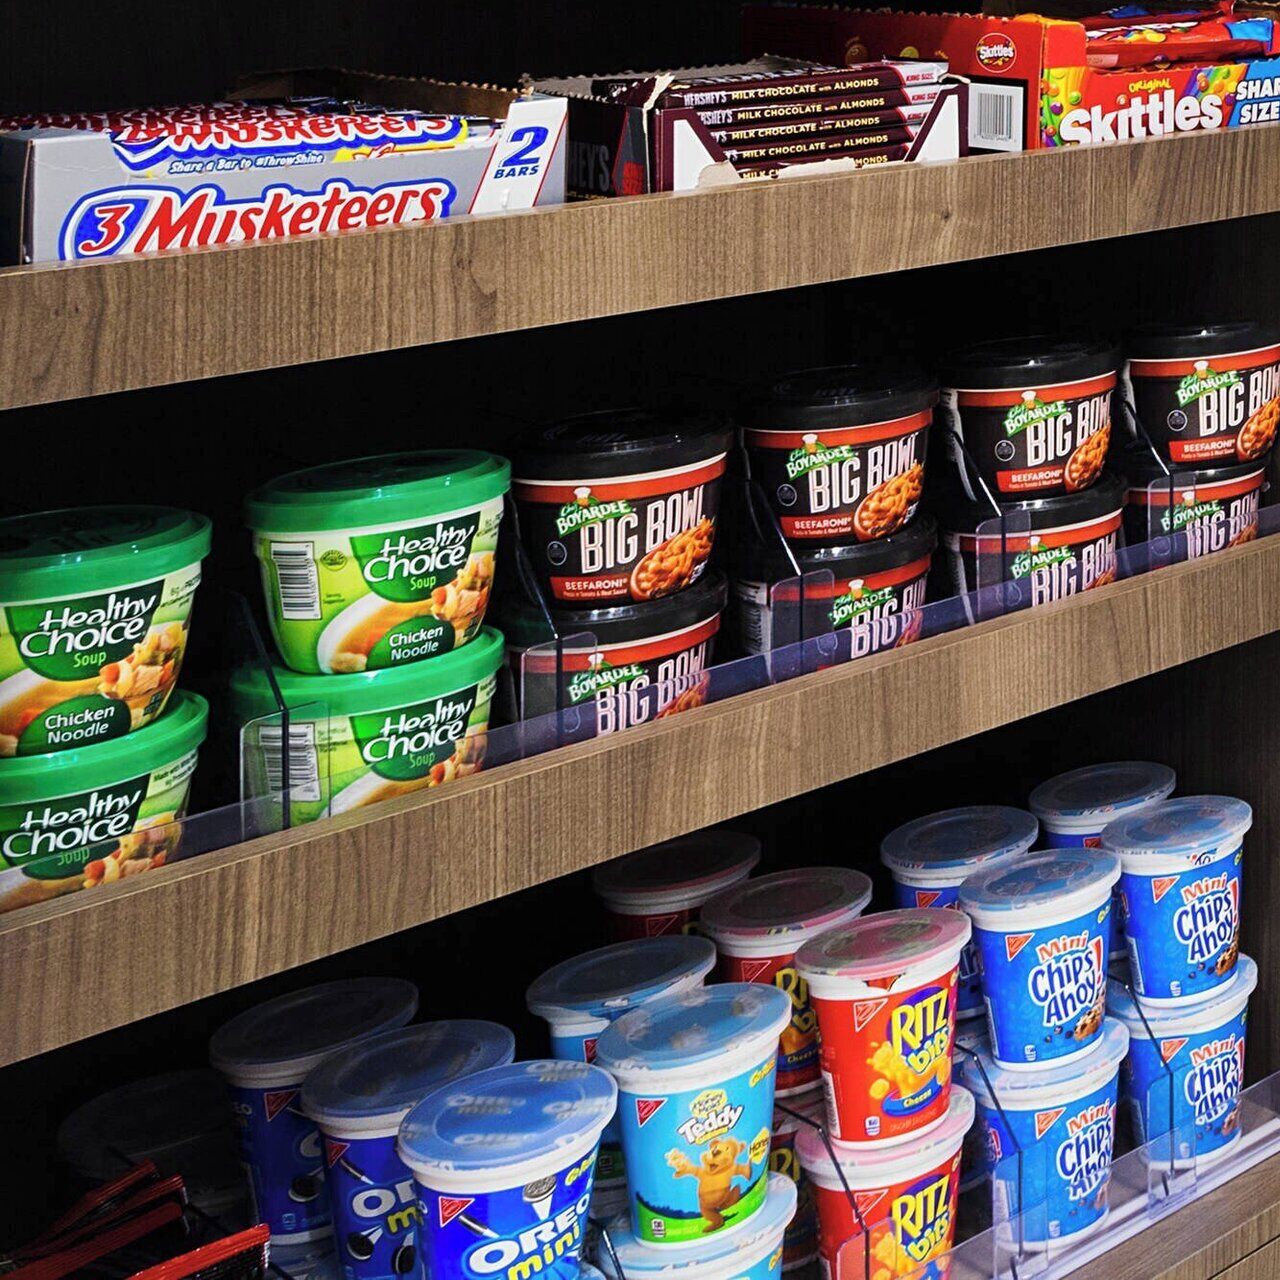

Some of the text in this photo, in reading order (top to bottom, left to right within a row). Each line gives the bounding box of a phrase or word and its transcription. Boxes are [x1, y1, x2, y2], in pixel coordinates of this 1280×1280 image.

[684, 91, 727, 107] HERSHEY'S
[731, 89, 756, 101] MILK
[758, 83, 817, 99] CHOCOLATE
[834, 78, 880, 90] ALMONDS
[906, 73, 921, 83] KING
[737, 108, 763, 120] MILK
[765, 103, 822, 118] CHOCOLATE
[840, 97, 885, 110] ALMONDS
[732, 116, 880, 140] MILK CHOCOLATE ALMONDS
[1060, 89, 1223, 145] Skittles
[1240, 101, 1280, 123] SIZE
[500, 126, 549, 168] 2
[742, 135, 889, 159] MILK CHOCOLATE ALMONDS
[169, 160, 202, 175] Share
[205, 161, 214, 172] a
[216, 159, 236, 171] Bar
[239, 159, 252, 170] to
[493, 165, 539, 180] BARS
[81, 187, 442, 253] 3 Musketeers
[1199, 382, 1244, 437] BIG
[1027, 411, 1072, 467] BIG
[381, 522, 475, 557] Healthy
[363, 545, 467, 583] Choice
[410, 575, 437, 591] Soup
[39, 593, 158, 633] Healthy
[20, 618, 145, 659] Choice
[389, 625, 443, 649] Chicken
[391, 640, 439, 661] Noodle
[73, 651, 107, 668] Soup
[45, 705, 115, 731] Chicken
[47, 722, 110, 745] Noodle
[381, 698, 473, 738] Healthy
[363, 720, 465, 763] Choice
[20, 789, 142, 830] Healthy
[2, 814, 131, 858] Choice
[1183, 872, 1227, 903] Mini
[1177, 889, 1231, 938] Chips
[1038, 930, 1089, 961] Mini
[1031, 949, 1095, 1005] Chips
[891, 988, 949, 1055] RITZ
[1192, 1033, 1236, 1066] Mini
[1186, 1050, 1239, 1105] Chips
[678, 1105, 745, 1145] Teddy
[1068, 1100, 1110, 1137] Mini
[1060, 1119, 1112, 1177] Chips
[891, 1174, 949, 1245] RITZ
[469, 1193, 590, 1274] OREO
